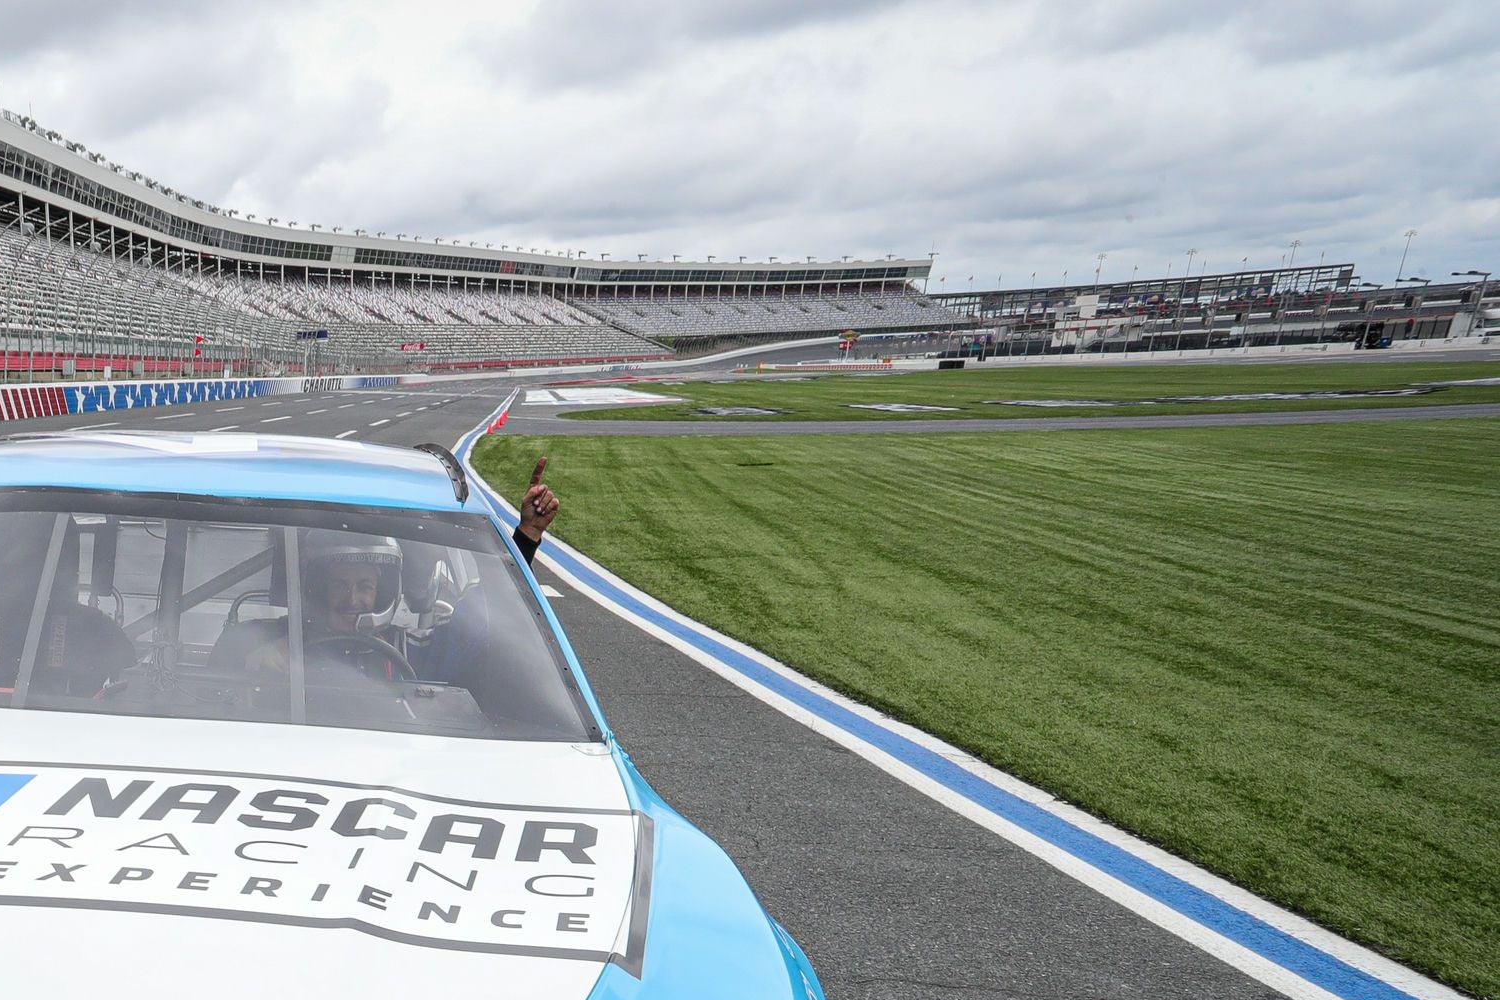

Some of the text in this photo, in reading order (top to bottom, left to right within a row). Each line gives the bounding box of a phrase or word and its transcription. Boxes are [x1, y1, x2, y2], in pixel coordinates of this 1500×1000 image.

[303, 377, 342, 393] CHARLOTTE
[43, 776, 598, 865] NASCAR
[7, 826, 596, 898] RACING
